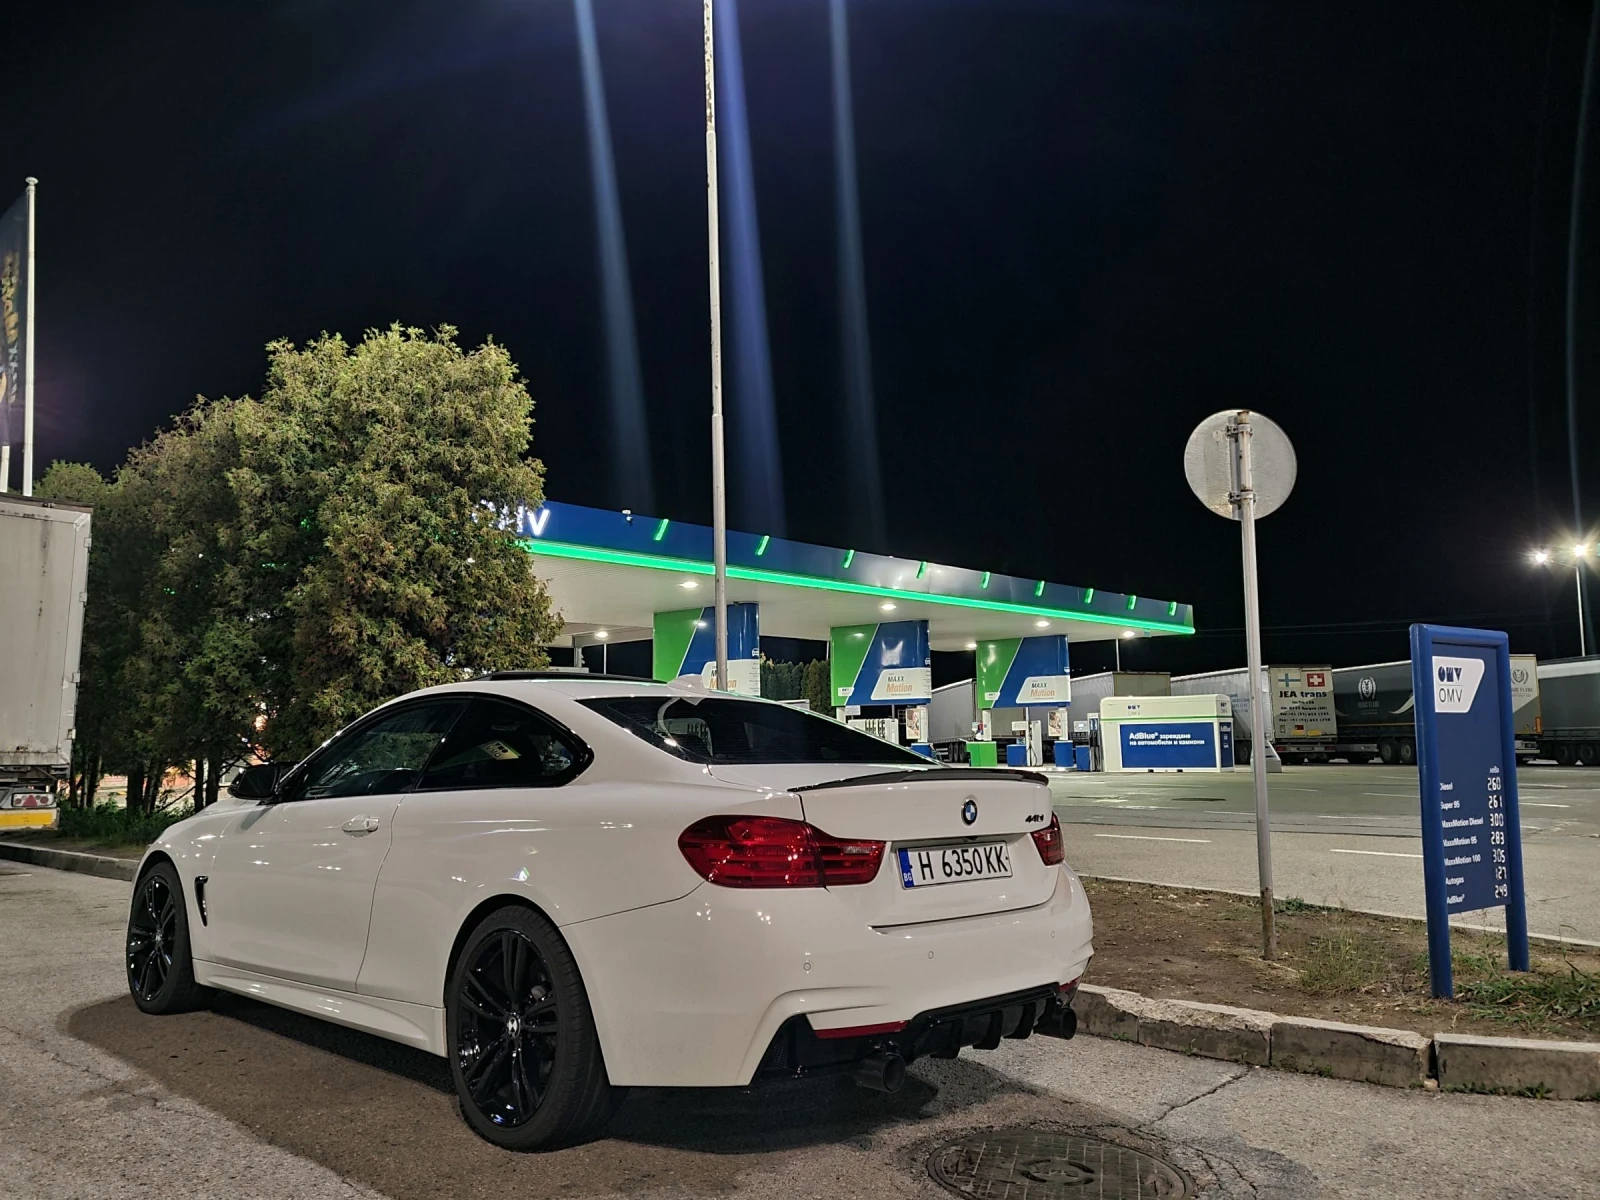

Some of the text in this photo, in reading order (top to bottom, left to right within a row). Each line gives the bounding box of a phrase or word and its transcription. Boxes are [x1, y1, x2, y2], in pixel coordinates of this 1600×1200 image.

[887, 675, 905, 683] MAXX
[886, 683, 913, 693] Motion
[1030, 688, 1056, 697] Motion
[1438, 688, 1463, 703] OMV
[1453, 800, 1460, 809] 95
[1469, 816, 1484, 826] Diesel
[1470, 835, 1478, 845] 95
[1472, 854, 1481, 863] 100
[903, 873, 913, 882] BG
[917, 852, 934, 880] H
[1445, 876, 1465, 886] Autogas
